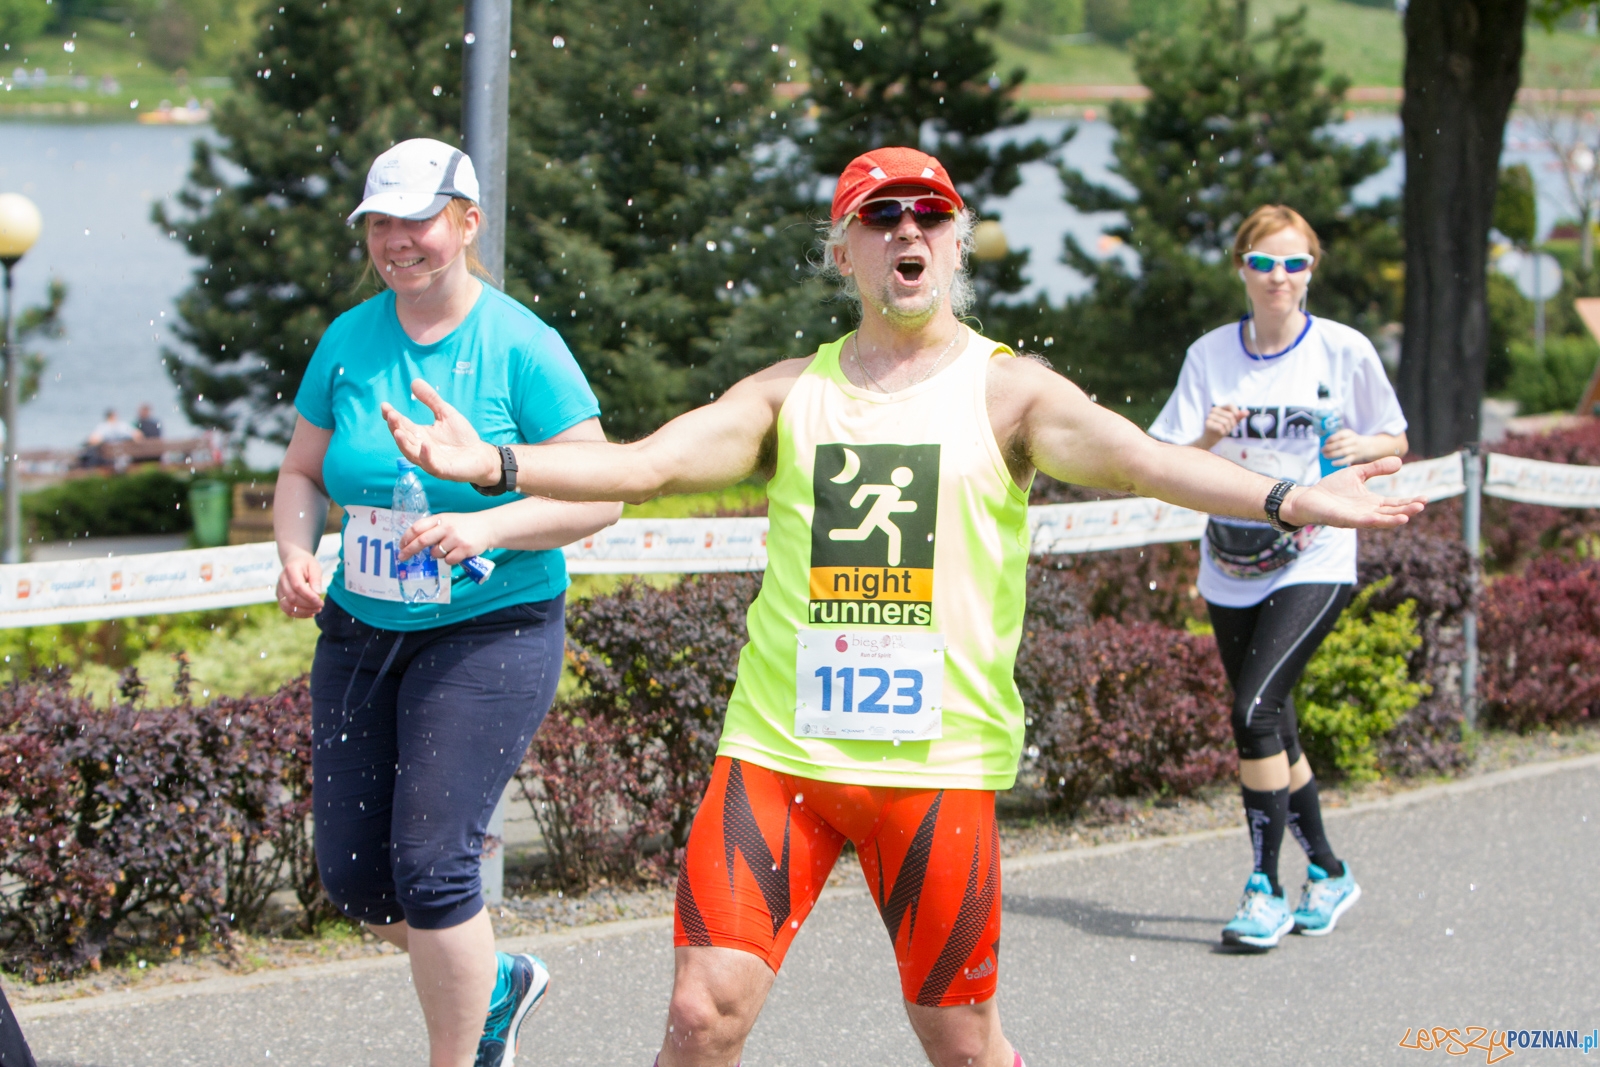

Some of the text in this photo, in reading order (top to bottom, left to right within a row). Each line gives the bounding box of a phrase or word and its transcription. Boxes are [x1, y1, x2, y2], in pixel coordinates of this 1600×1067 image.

[833, 567, 912, 599] night
[809, 601, 931, 625] runners
[835, 633, 879, 653] 6 bieg
[814, 666, 924, 715] 1123
